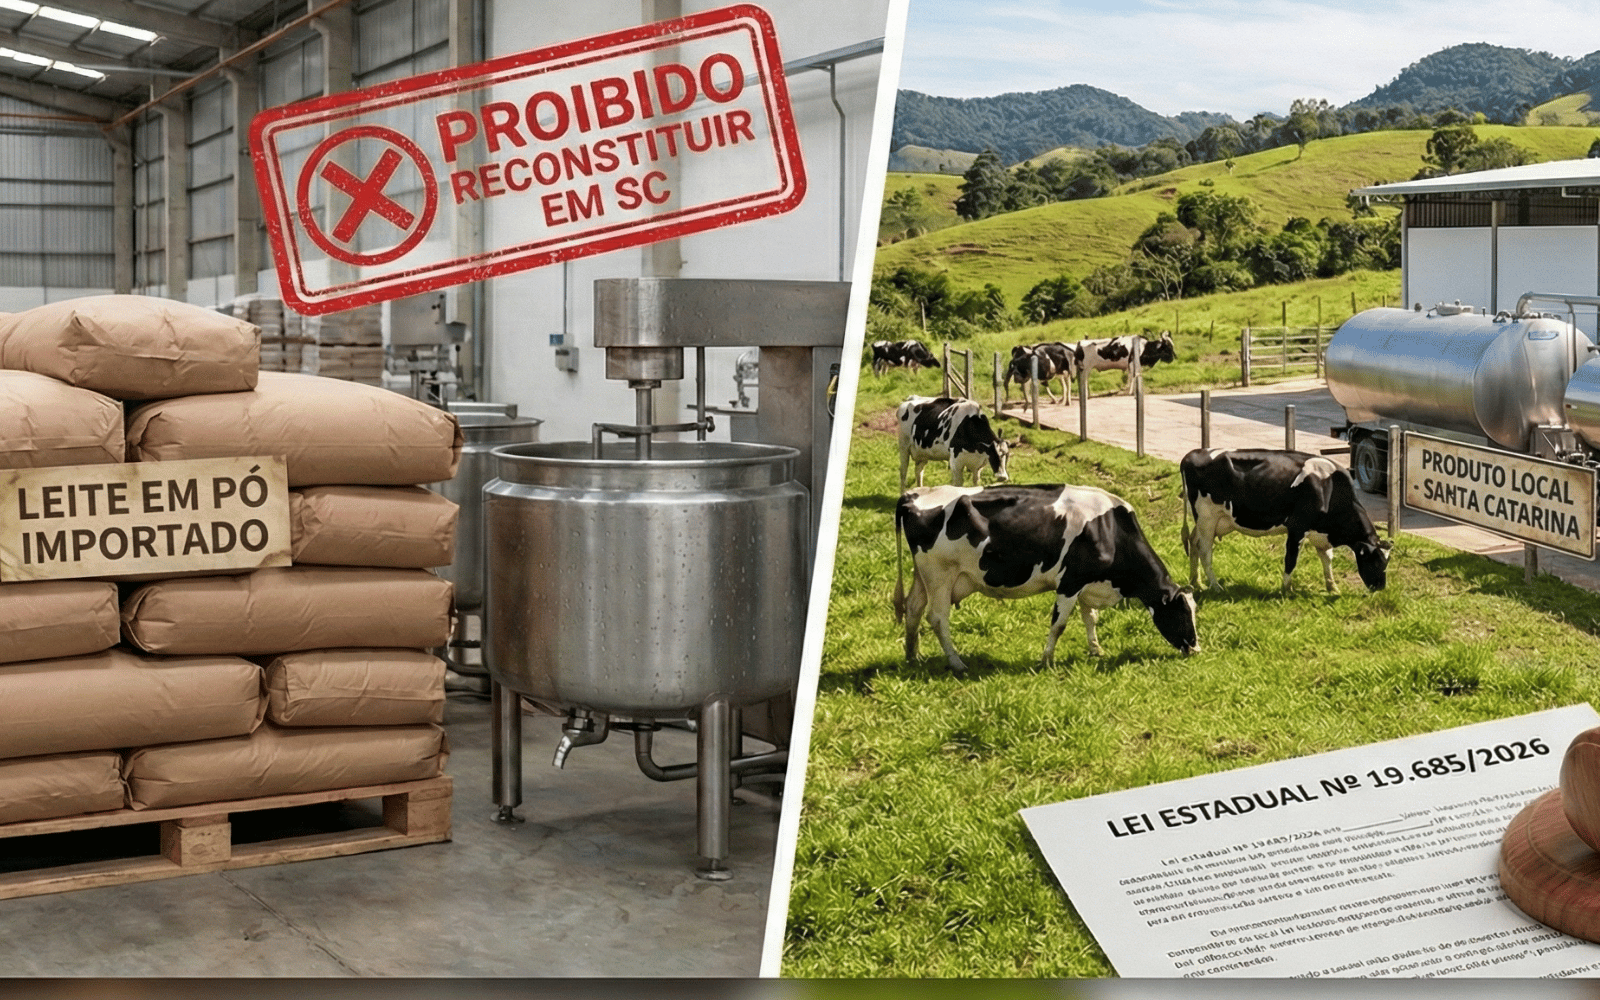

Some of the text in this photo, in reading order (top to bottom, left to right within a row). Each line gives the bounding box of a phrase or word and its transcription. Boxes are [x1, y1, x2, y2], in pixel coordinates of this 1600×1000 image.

[18, 464, 269, 520] LEITE EM PÓ
[1422, 449, 1574, 506] PRODUTO LOCAL
[1424, 478, 1480, 513] SANTA
[1484, 494, 1581, 541] CATARINA
[22, 518, 269, 565] IMPORTADO
[1107, 813, 1156, 838] LEI
[1158, 784, 1319, 828] ESTADUAL
[1320, 774, 1362, 797] Nº
[1366, 738, 1550, 788] 19.685/2026
